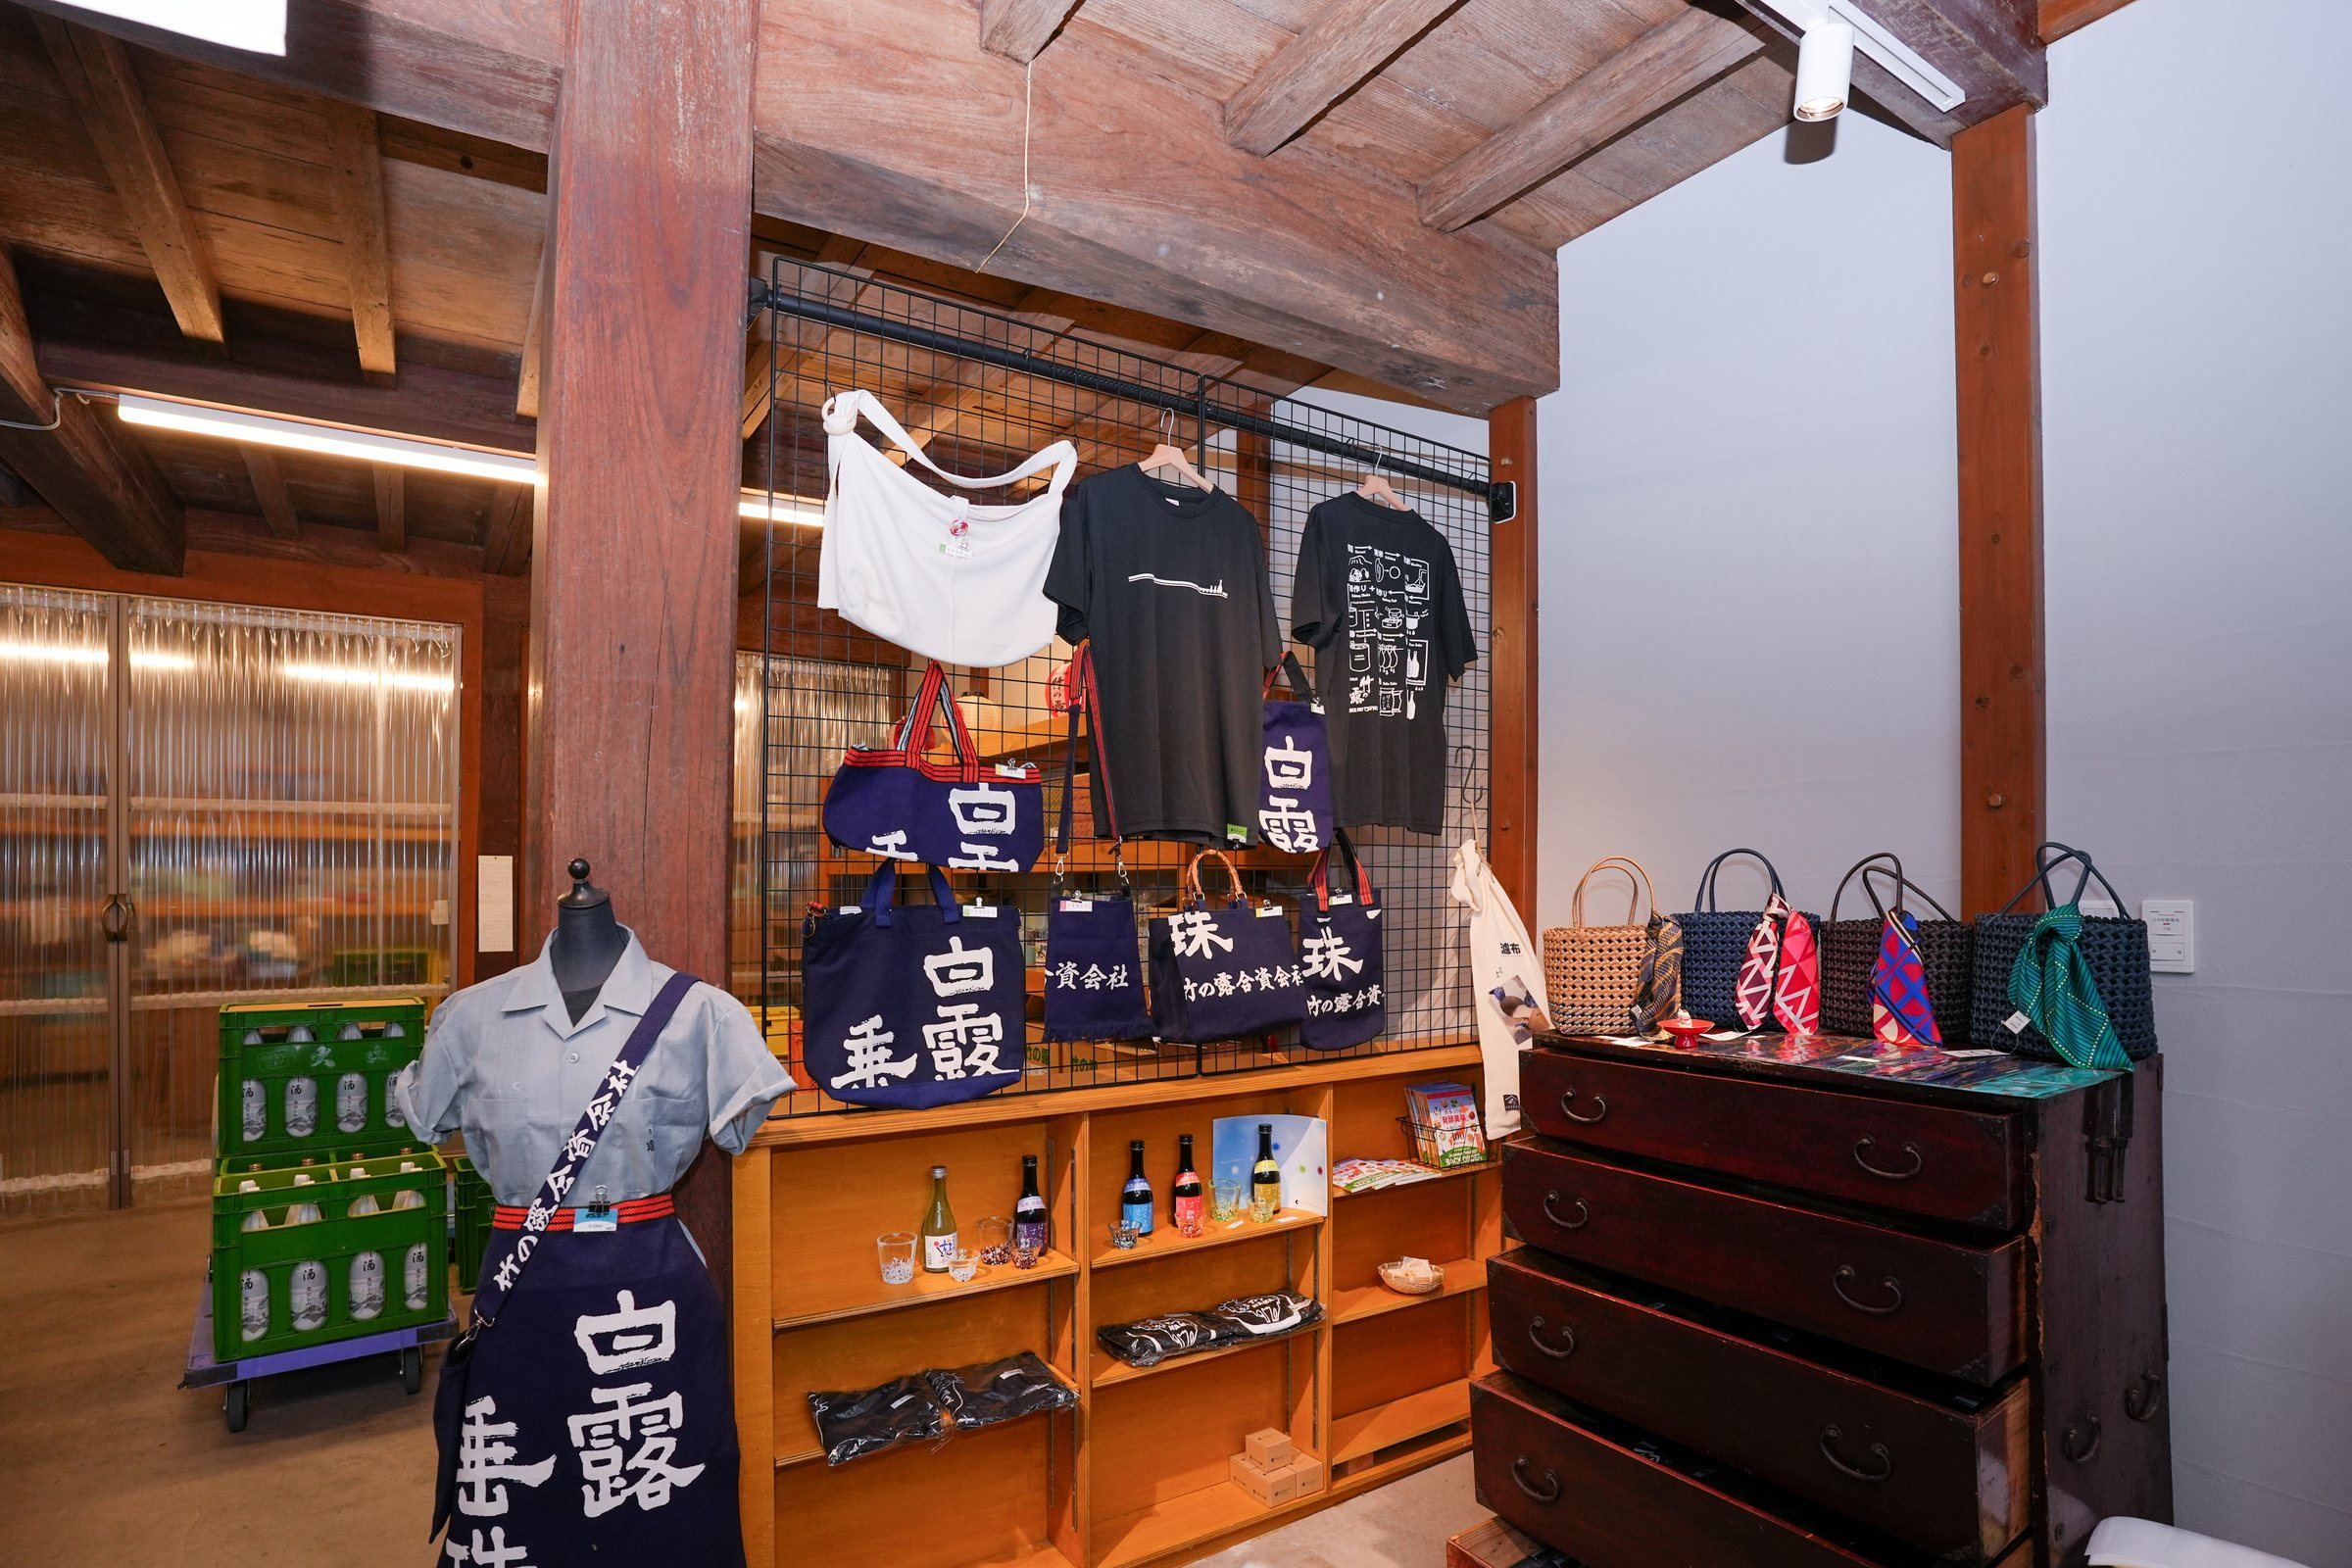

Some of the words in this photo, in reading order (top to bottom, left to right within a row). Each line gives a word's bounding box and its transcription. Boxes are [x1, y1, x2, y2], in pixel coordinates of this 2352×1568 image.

[1301, 925, 1364, 982] 珠
[1045, 960, 1129, 991] 資会社
[1306, 984, 1386, 1017] 竹の露合資
